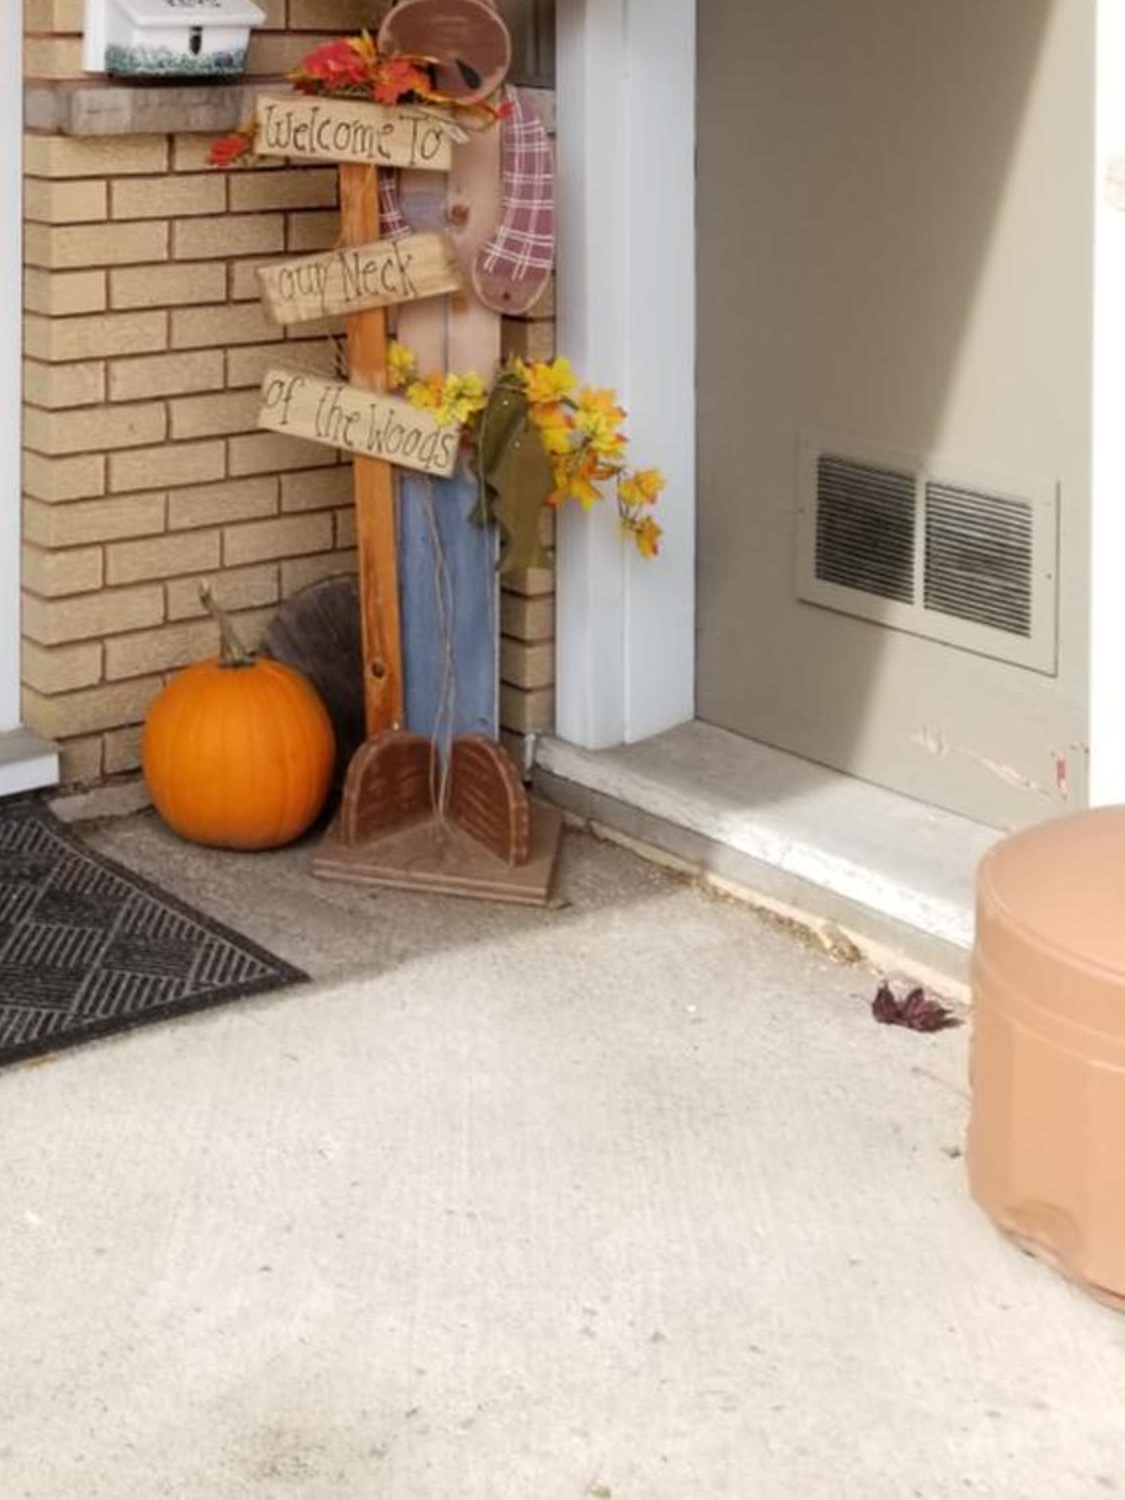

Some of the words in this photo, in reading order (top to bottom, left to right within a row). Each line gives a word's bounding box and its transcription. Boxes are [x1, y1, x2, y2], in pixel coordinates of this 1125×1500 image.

[265, 104, 392, 160] Welcome
[338, 241, 418, 303] Neck
[266, 375, 306, 426] of
